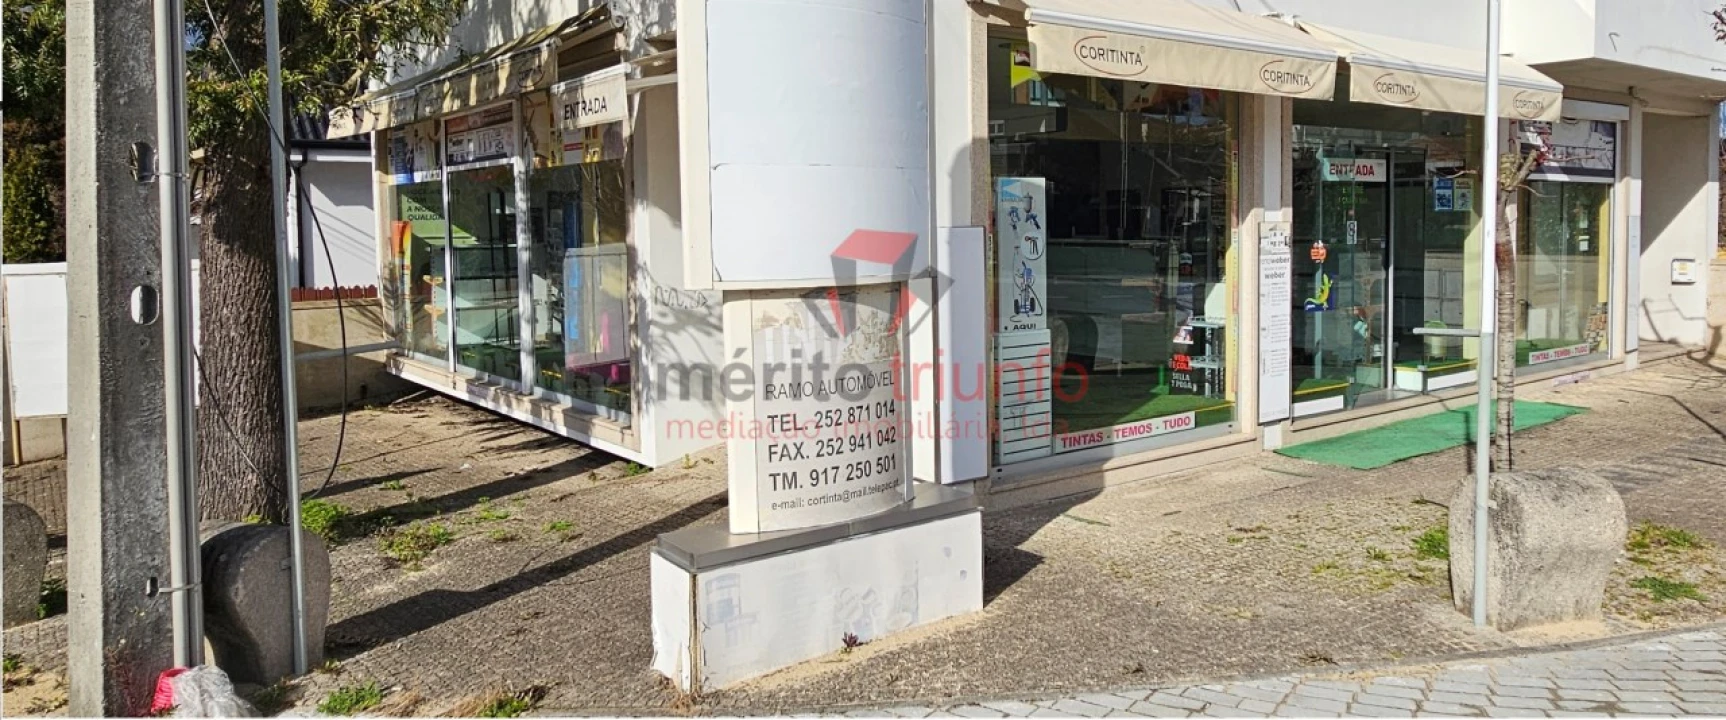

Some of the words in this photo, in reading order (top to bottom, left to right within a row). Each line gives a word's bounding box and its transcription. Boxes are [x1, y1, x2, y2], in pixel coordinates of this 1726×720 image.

[1079, 45, 1143, 66] CORITINTA
[1263, 69, 1312, 86] CORITINTA
[564, 96, 608, 121] ENTRADA
[765, 381, 814, 401] RAMO
[817, 370, 895, 396] AUTOMÓVEL
[767, 413, 809, 434] TEL.
[814, 408, 843, 430] 252
[847, 403, 871, 425] 871
[875, 399, 896, 419] 014
[768, 441, 810, 463] FAX.
[815, 437, 844, 458] 252
[849, 432, 872, 453] 941
[877, 426, 897, 447] 042
[1060, 432, 1104, 449] TINTAS
[1113, 423, 1153, 440] TEMOS
[1162, 416, 1192, 431] TUDO
[769, 471, 803, 492] TM.
[809, 466, 840, 488] 917
[845, 460, 872, 482] 250
[876, 453, 897, 474] 501
[772, 498, 805, 510] e-mail:
